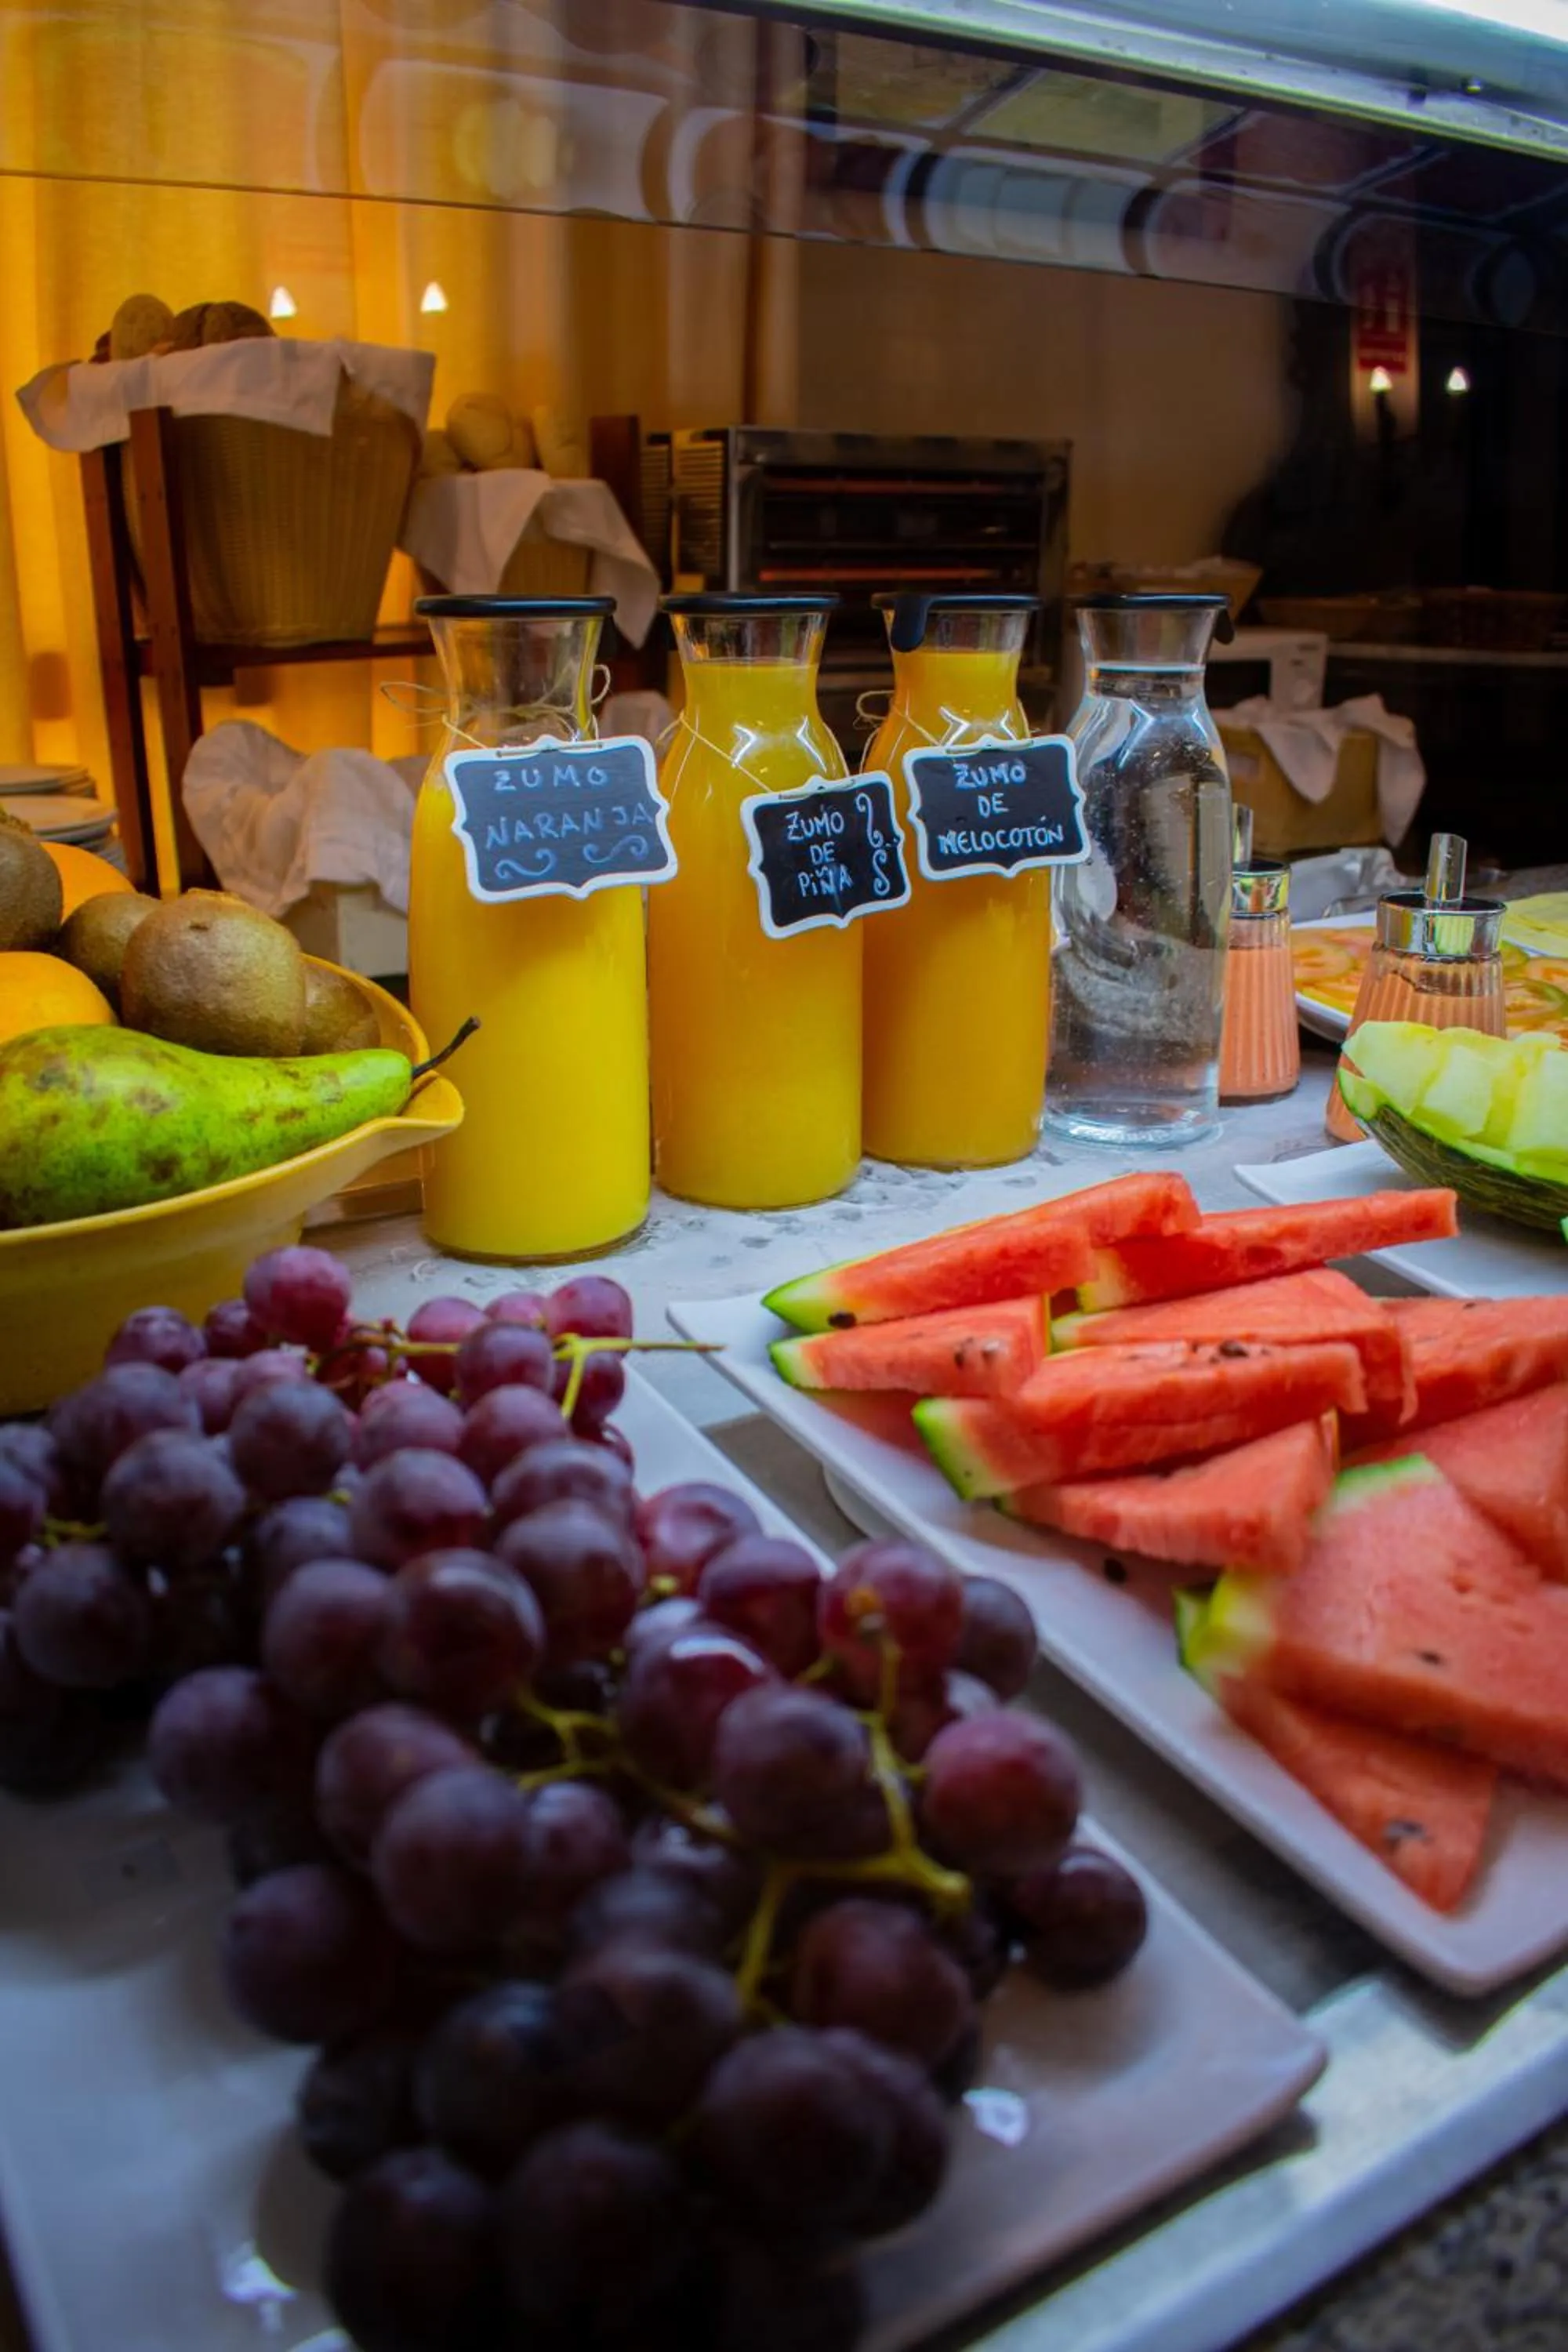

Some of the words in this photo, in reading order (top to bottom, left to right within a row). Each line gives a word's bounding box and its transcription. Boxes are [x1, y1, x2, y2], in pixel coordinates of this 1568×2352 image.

[493, 764, 608, 792] ZUMO
[953, 760, 1027, 789] ZUMO
[978, 793, 1010, 818] DE
[485, 802, 655, 849] NARANJA
[785, 811, 845, 841] ZUMO
[938, 815, 1065, 855] MELOCOTÓN
[809, 841, 836, 865] DE
